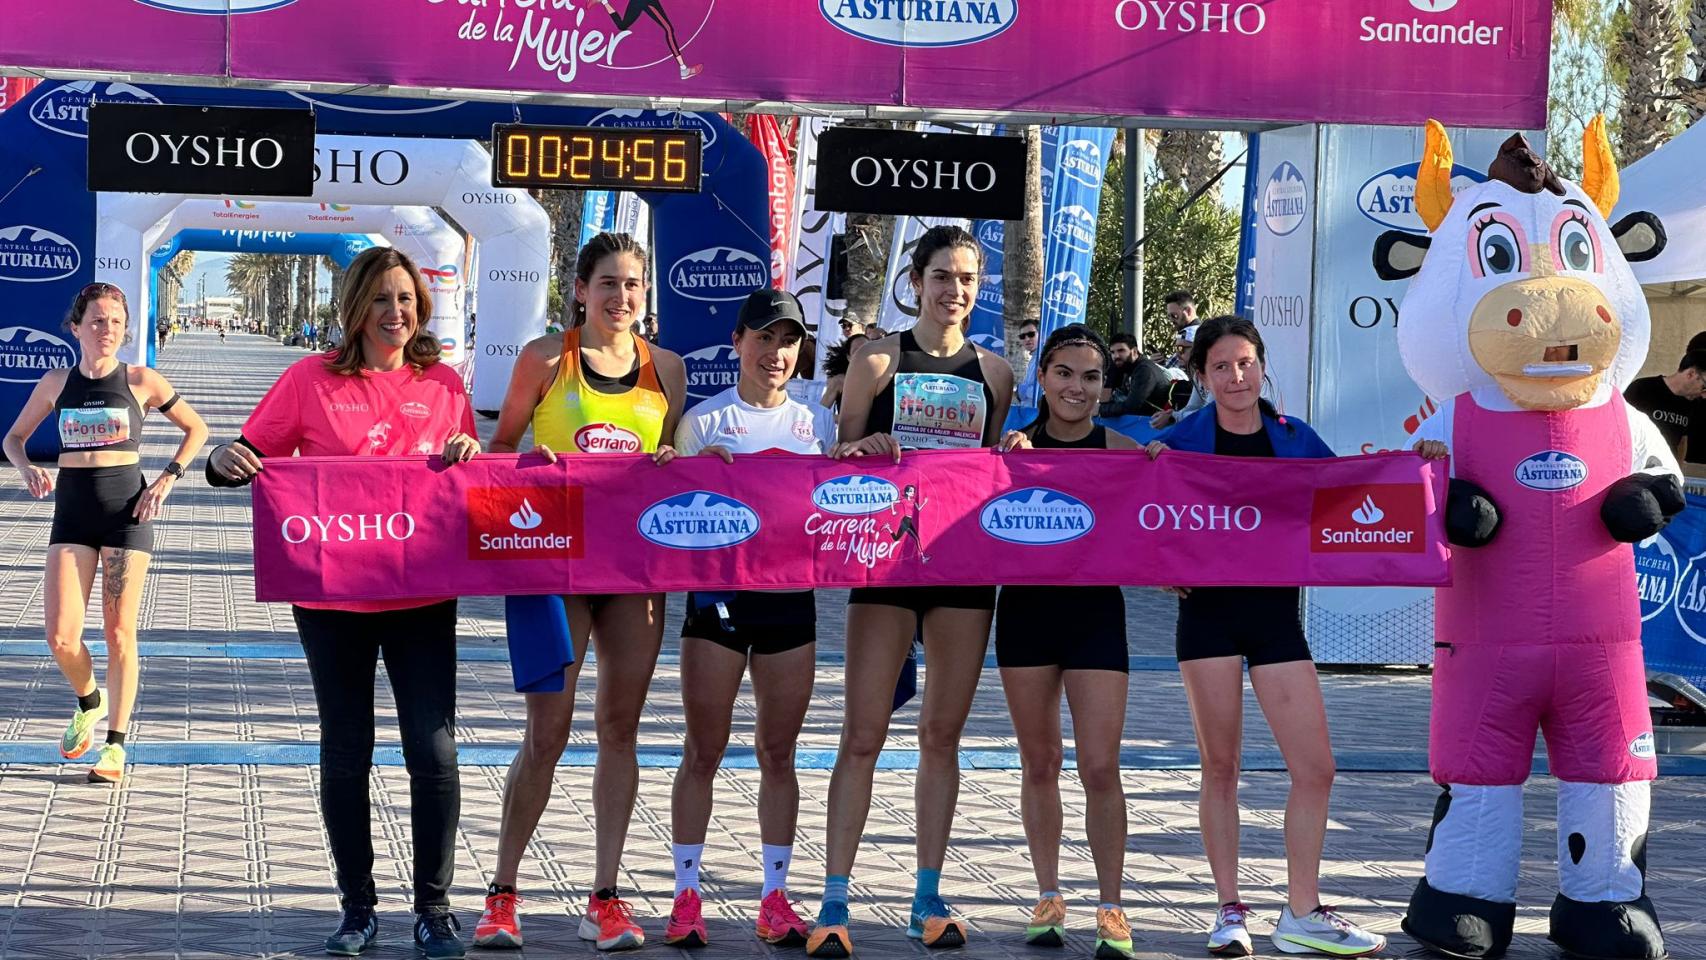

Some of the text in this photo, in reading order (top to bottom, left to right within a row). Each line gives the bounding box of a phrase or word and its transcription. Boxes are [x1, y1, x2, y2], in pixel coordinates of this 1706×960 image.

[833, 0, 1002, 24] ASTURIANA
[1115, 0, 1266, 35] OYSHO
[458, 8, 513, 42] de la
[1360, 16, 1503, 45] Santander
[508, 8, 632, 83] Mujer
[126, 132, 283, 169] OYSHO
[508, 135, 686, 182] 00:24:56
[850, 156, 997, 192] OYSHO
[462, 191, 517, 204] OYSHO
[1266, 190, 1304, 218] ASTURIANA
[212, 211, 260, 219] TotalEnergies
[307, 214, 355, 222] TotalEnergies
[33, 245, 71, 253] LECHERA
[489, 269, 540, 283] OYSHO
[675, 267, 763, 288] ASTURIANA
[1260, 296, 1304, 328] OYSHO
[28, 346, 67, 354] LECHERA
[924, 404, 958, 420] 016
[1652, 409, 1689, 427] OYSHO
[81, 424, 106, 435] 016
[580, 431, 637, 451] Serrano
[1521, 464, 1583, 480] ASTURIANA
[820, 488, 893, 505] ASTURIANA
[648, 512, 751, 535] ASTURIANA
[665, 510, 704, 518] CENTRAL
[804, 512, 877, 535] Carrera
[988, 507, 1086, 530] ASTURIANA
[1138, 503, 1262, 531] OYSHO
[281, 511, 415, 544] OYSHO
[1321, 527, 1414, 544] Santander
[479, 532, 573, 551] Santander
[820, 532, 847, 551] de la
[843, 532, 901, 569] Mujer
